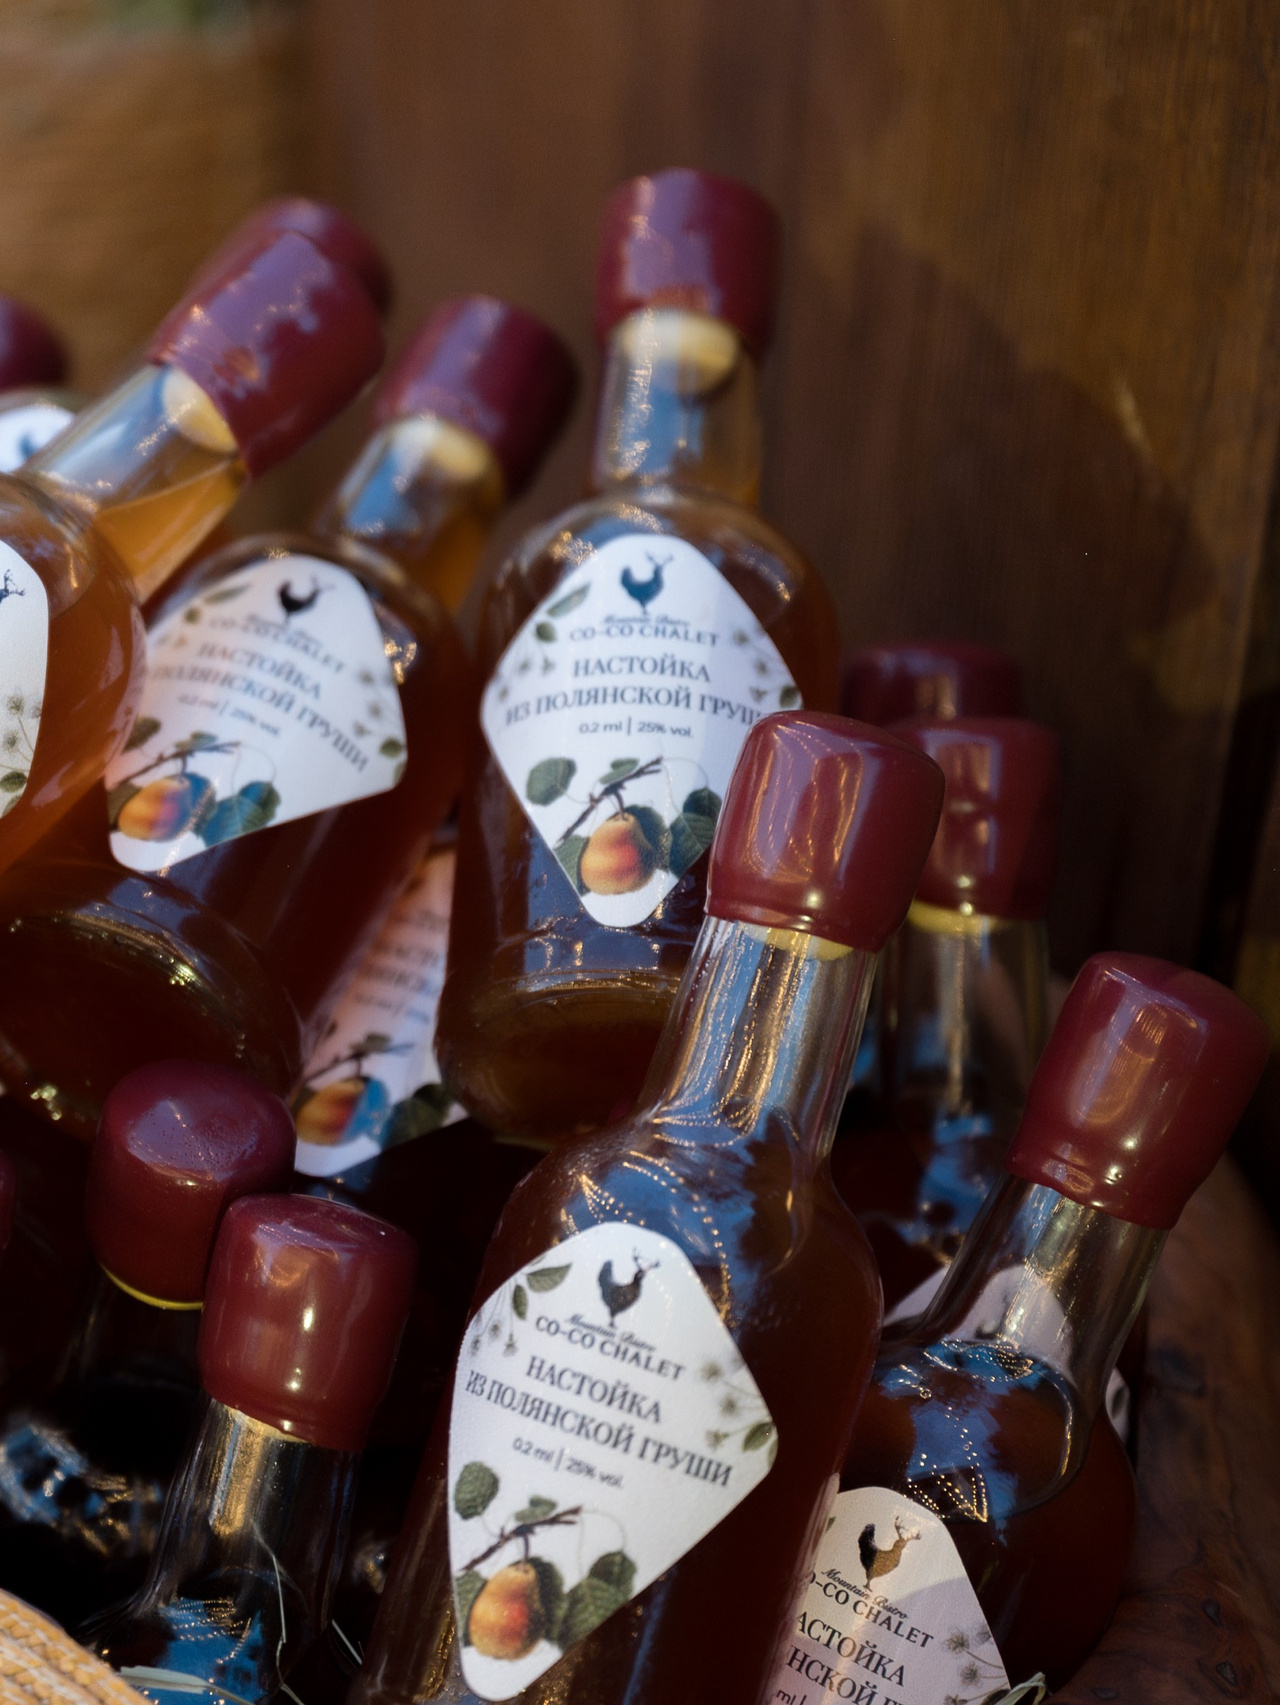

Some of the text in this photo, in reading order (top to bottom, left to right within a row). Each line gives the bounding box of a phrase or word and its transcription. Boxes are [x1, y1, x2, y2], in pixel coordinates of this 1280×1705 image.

[570, 625, 719, 647] CO-CO CHALET
[196, 641, 321, 700] НАСТОЙКА
[573, 653, 711, 683] НАСТОЙКА
[504, 684, 762, 726] ИЗ ПОЛЯНСКОЙ ГРУШ
[603, 720, 623, 733] ml
[637, 721, 667, 734] 25%
[295, 704, 369, 773] ГРУШИ
[535, 1315, 687, 1381] CO-CO CHALET
[525, 1355, 663, 1424] НАСТОЙКА
[465, 1369, 733, 1488] ИЗ ПОЛЯНСКОЙ ГРУШИ
[821, 1568, 909, 1619] Mountain Bistro
[797, 1611, 905, 1687] АСТОЙКА
[852, 1599, 934, 1648] CHALET
[786, 1645, 878, 1705] НСКОЙ
